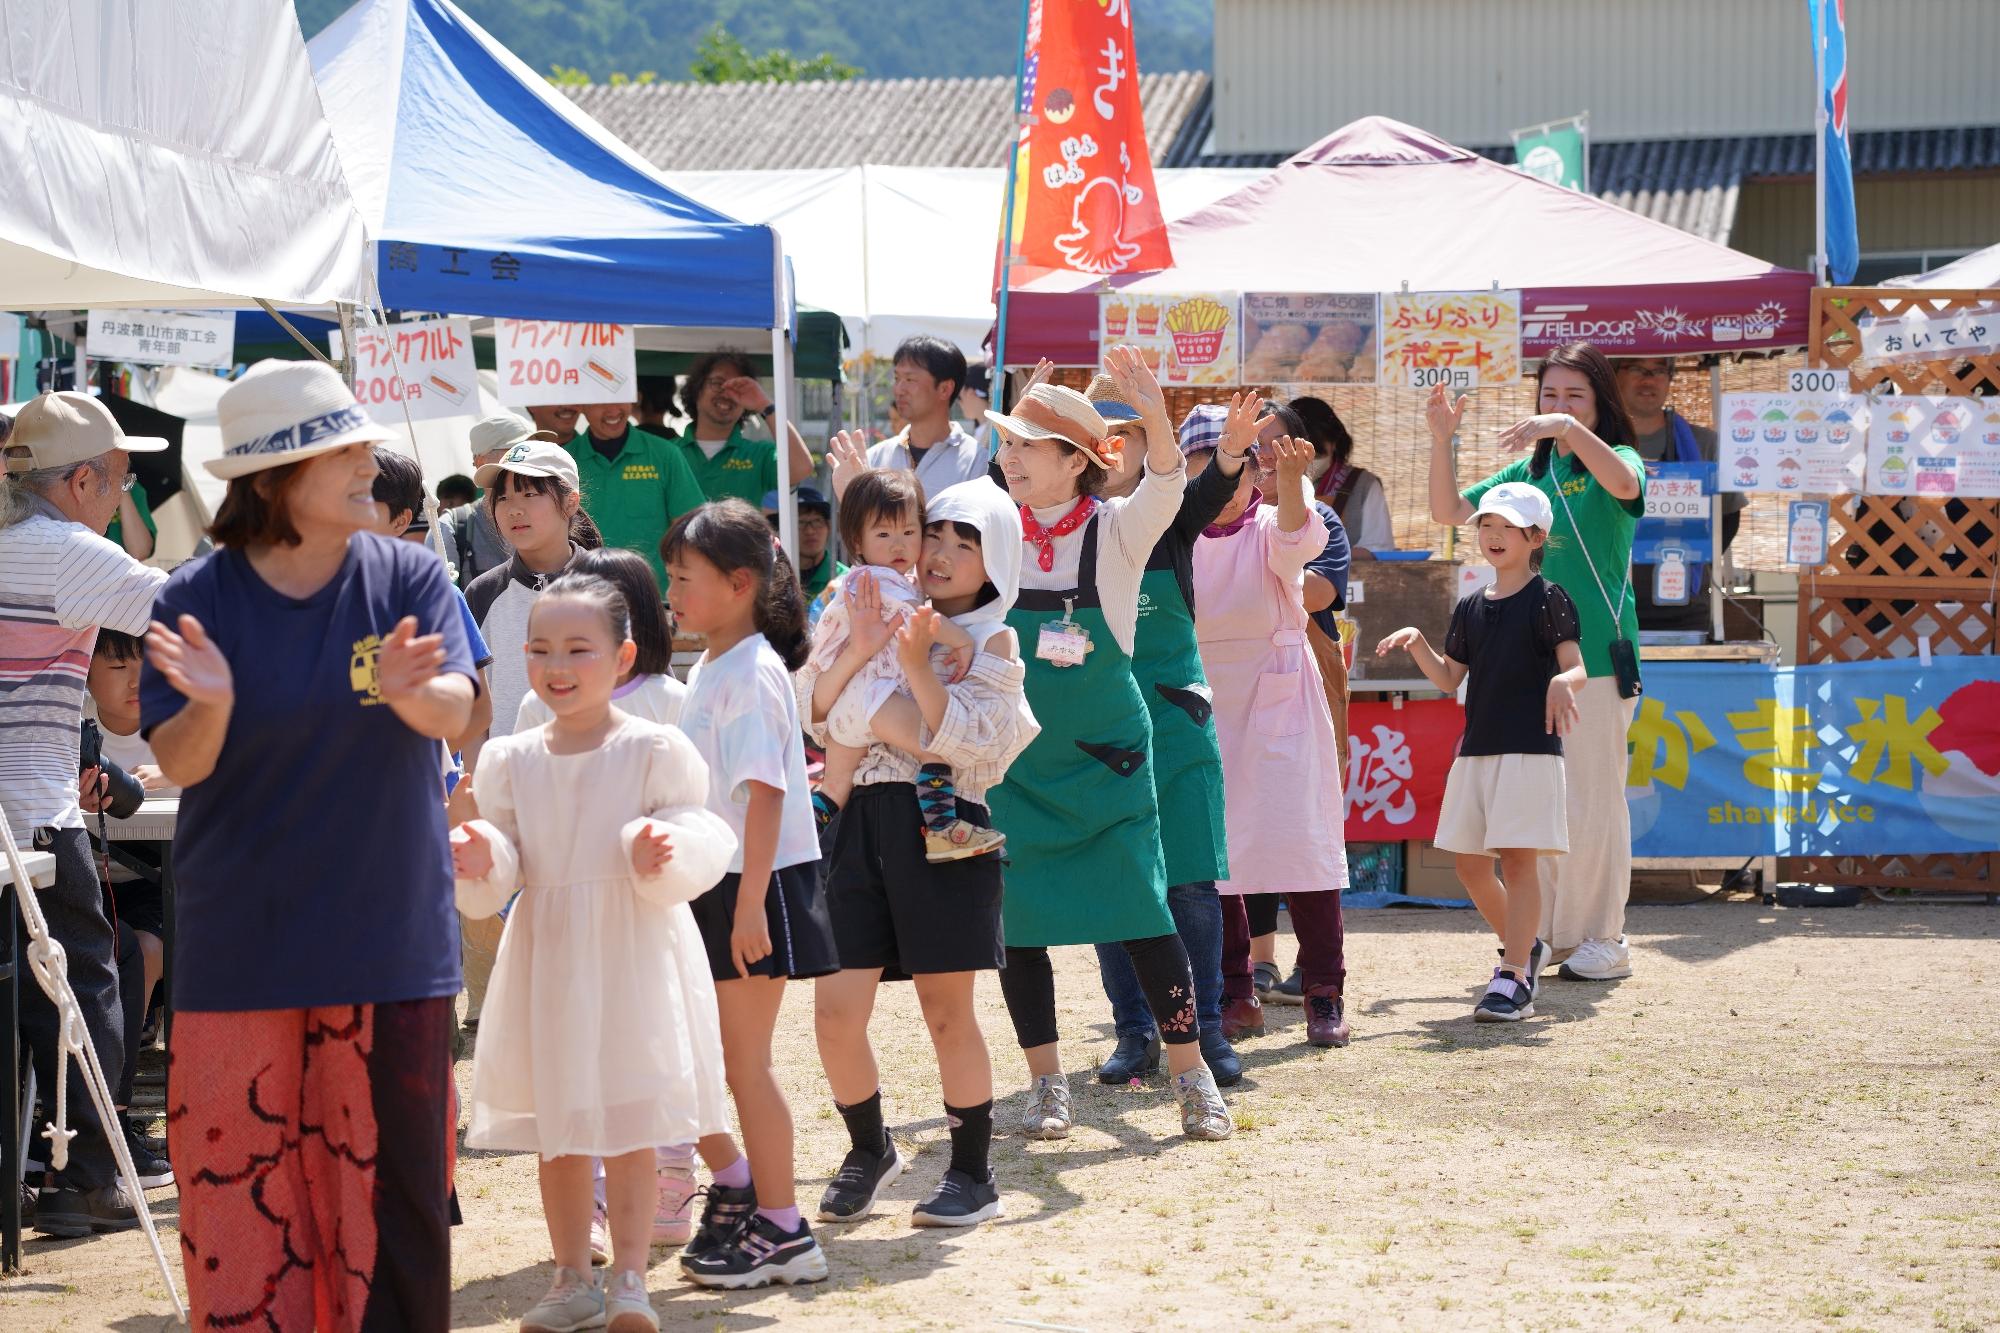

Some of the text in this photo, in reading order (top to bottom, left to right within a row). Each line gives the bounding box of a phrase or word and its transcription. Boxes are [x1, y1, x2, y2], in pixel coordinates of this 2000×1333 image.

[388, 242, 521, 281] 商工会
[1392, 305, 1499, 330] ふりふり
[1545, 321, 1636, 337] FIELDOOR
[101, 321, 217, 344] 丹波篠山市商工会
[1583, 337, 1636, 347] ttostyle.jp
[1885, 325, 1986, 352] おいでや
[138, 340, 181, 354] 青年部
[358, 327, 463, 368] ランクフルト
[1401, 340, 1493, 368] ポテト
[510, 358, 579, 386] 200円
[1414, 367, 1469, 387] 300円
[355, 376, 422, 405] 200円
[1649, 481, 1699, 496] かき氷
[1646, 502, 1699, 514] 300円
[1626, 694, 1951, 791] かき氷
[1707, 800, 1876, 824] shaved ice
